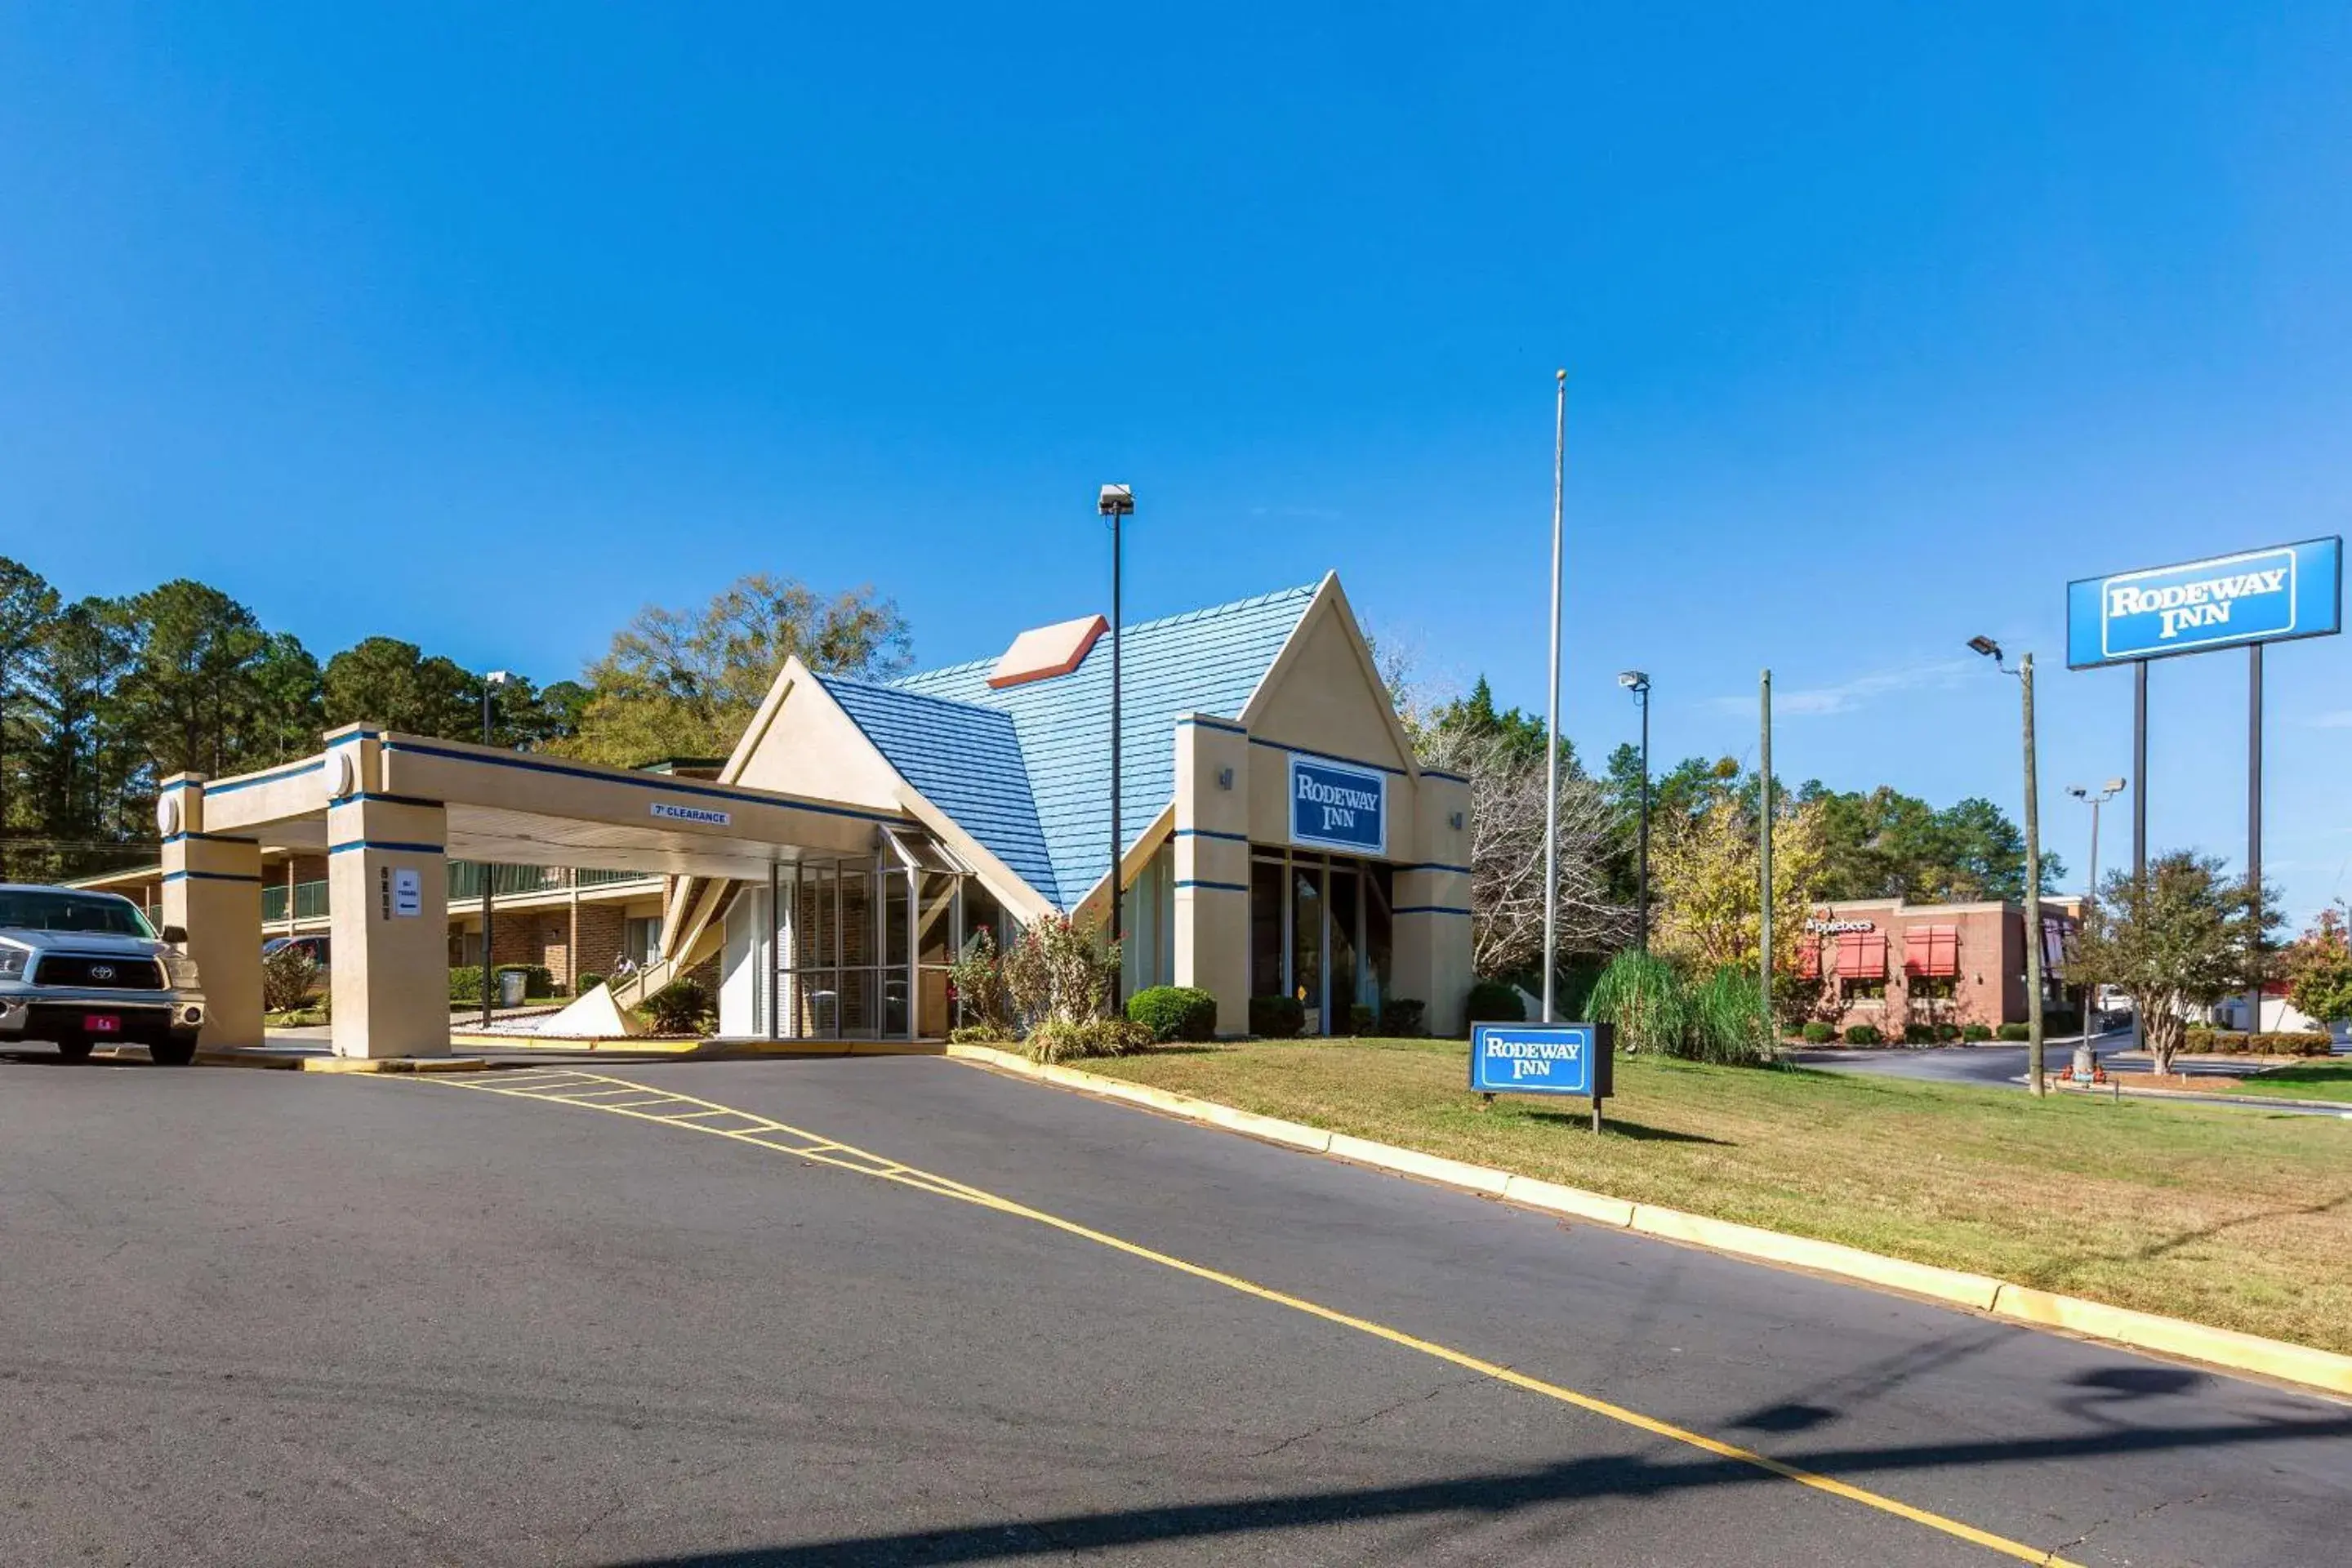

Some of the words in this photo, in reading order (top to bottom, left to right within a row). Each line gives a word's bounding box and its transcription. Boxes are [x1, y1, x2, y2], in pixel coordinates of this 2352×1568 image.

[2109, 568, 2287, 617] RODEWAY
[2159, 600, 2232, 639] INN
[1297, 773, 1379, 811] RODEWAY
[655, 805, 664, 814] 7'
[666, 807, 726, 823] CLEARANCE
[1321, 805, 1355, 831] INN
[1486, 1037, 1580, 1059] RODEWAY
[1512, 1059, 1551, 1079] INN
